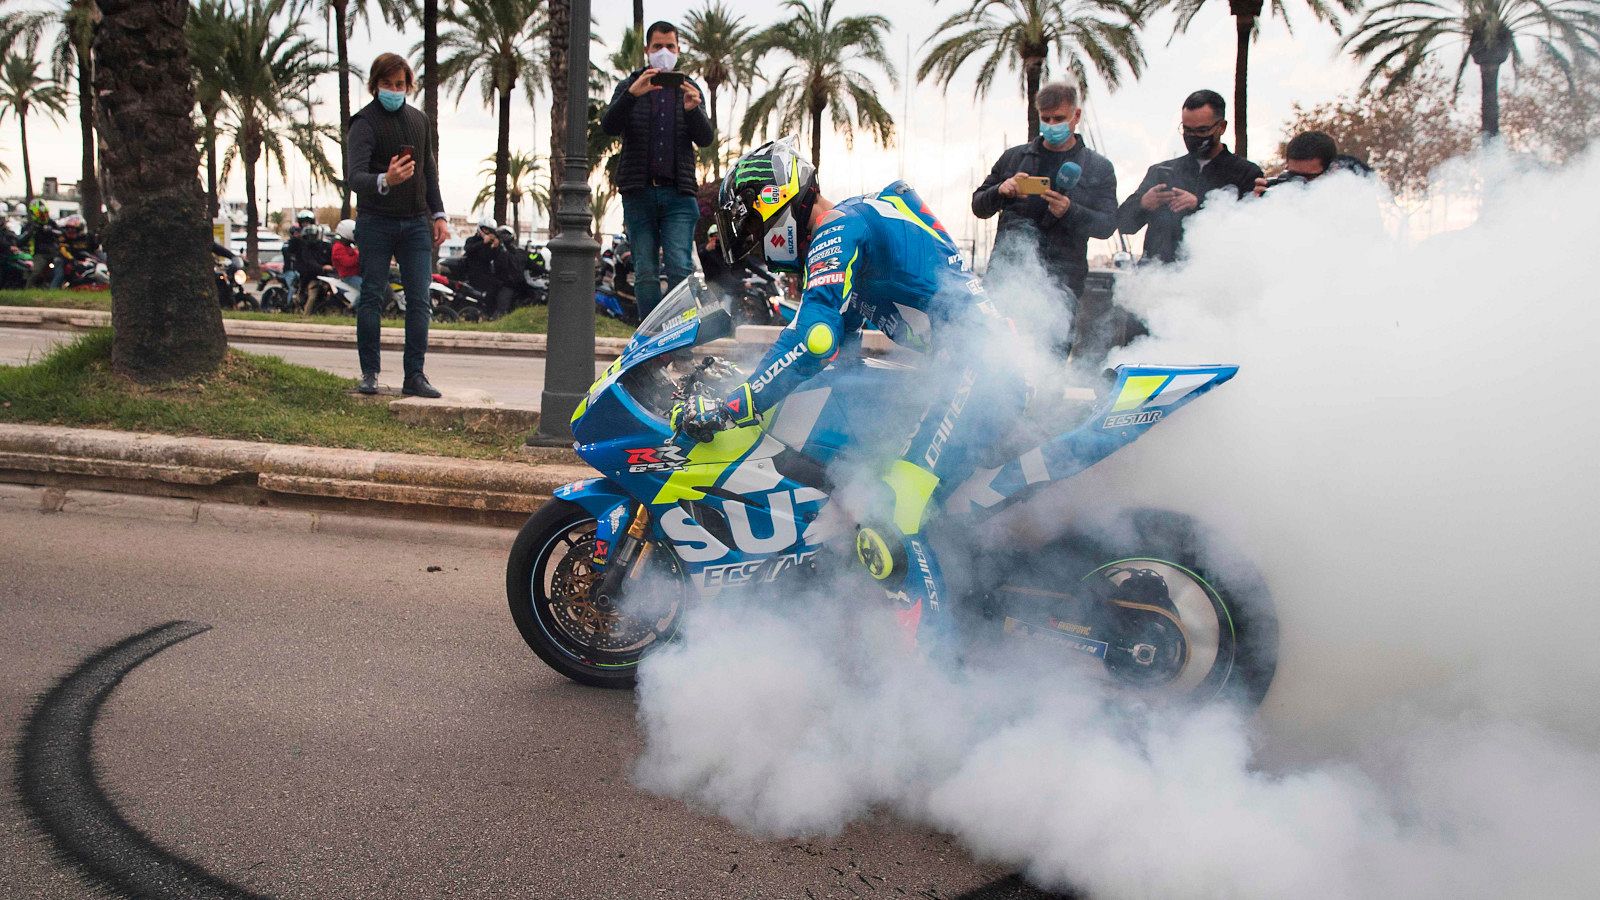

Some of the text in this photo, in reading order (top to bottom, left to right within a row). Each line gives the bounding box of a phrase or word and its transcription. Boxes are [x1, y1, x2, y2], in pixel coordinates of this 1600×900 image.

[807, 237, 842, 258] SUZUKI
[806, 273, 844, 290] MOTUL
[751, 342, 808, 393] SUZUKI
[1103, 411, 1163, 429] ECSTAR
[911, 540, 939, 612] DAINESE
